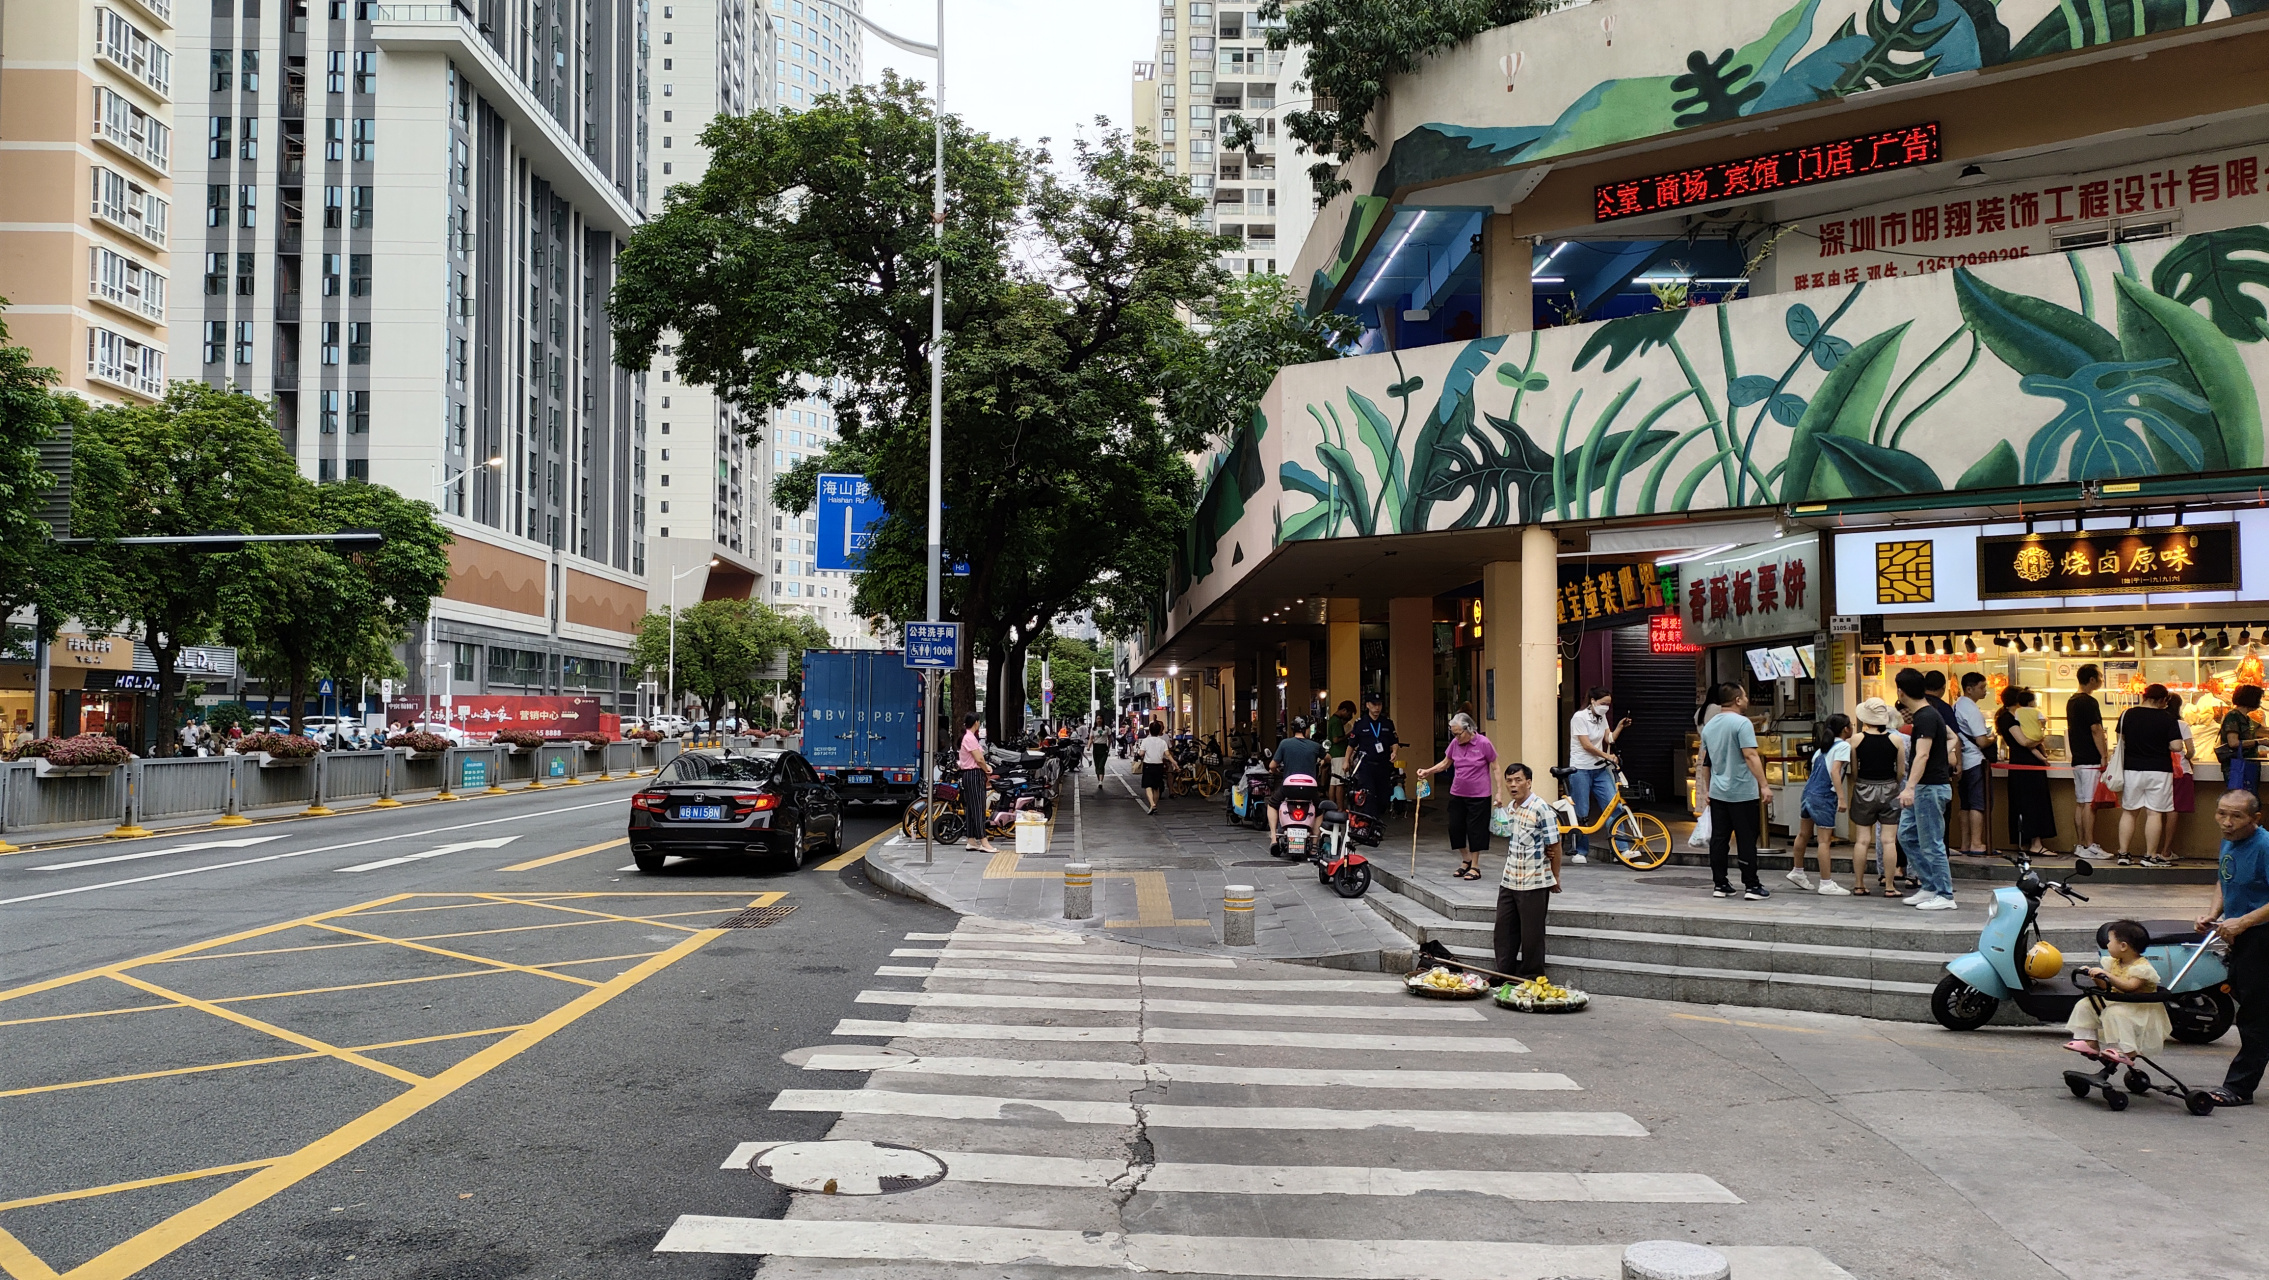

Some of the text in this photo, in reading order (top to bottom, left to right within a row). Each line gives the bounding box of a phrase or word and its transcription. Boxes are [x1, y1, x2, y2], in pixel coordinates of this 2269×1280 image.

[1657, 170, 1709, 206] 商场
[1724, 158, 1778, 193] 宾馆
[1799, 143, 1853, 179] 门店
[1871, 129, 1930, 168] 广告
[1819, 155, 2269, 258] 深圳市明翔装饰工程设计有限
[822, 480, 870, 497] 海山路
[828, 496, 865, 504] Haishan Rd
[2060, 545, 2195, 576] 烧卤原味
[1688, 558, 1807, 625] 香酥板栗饼
[909, 626, 954, 638] 公共洗手间
[932, 645, 953, 656] 100米
[519, 710, 559, 721] 营销中心
